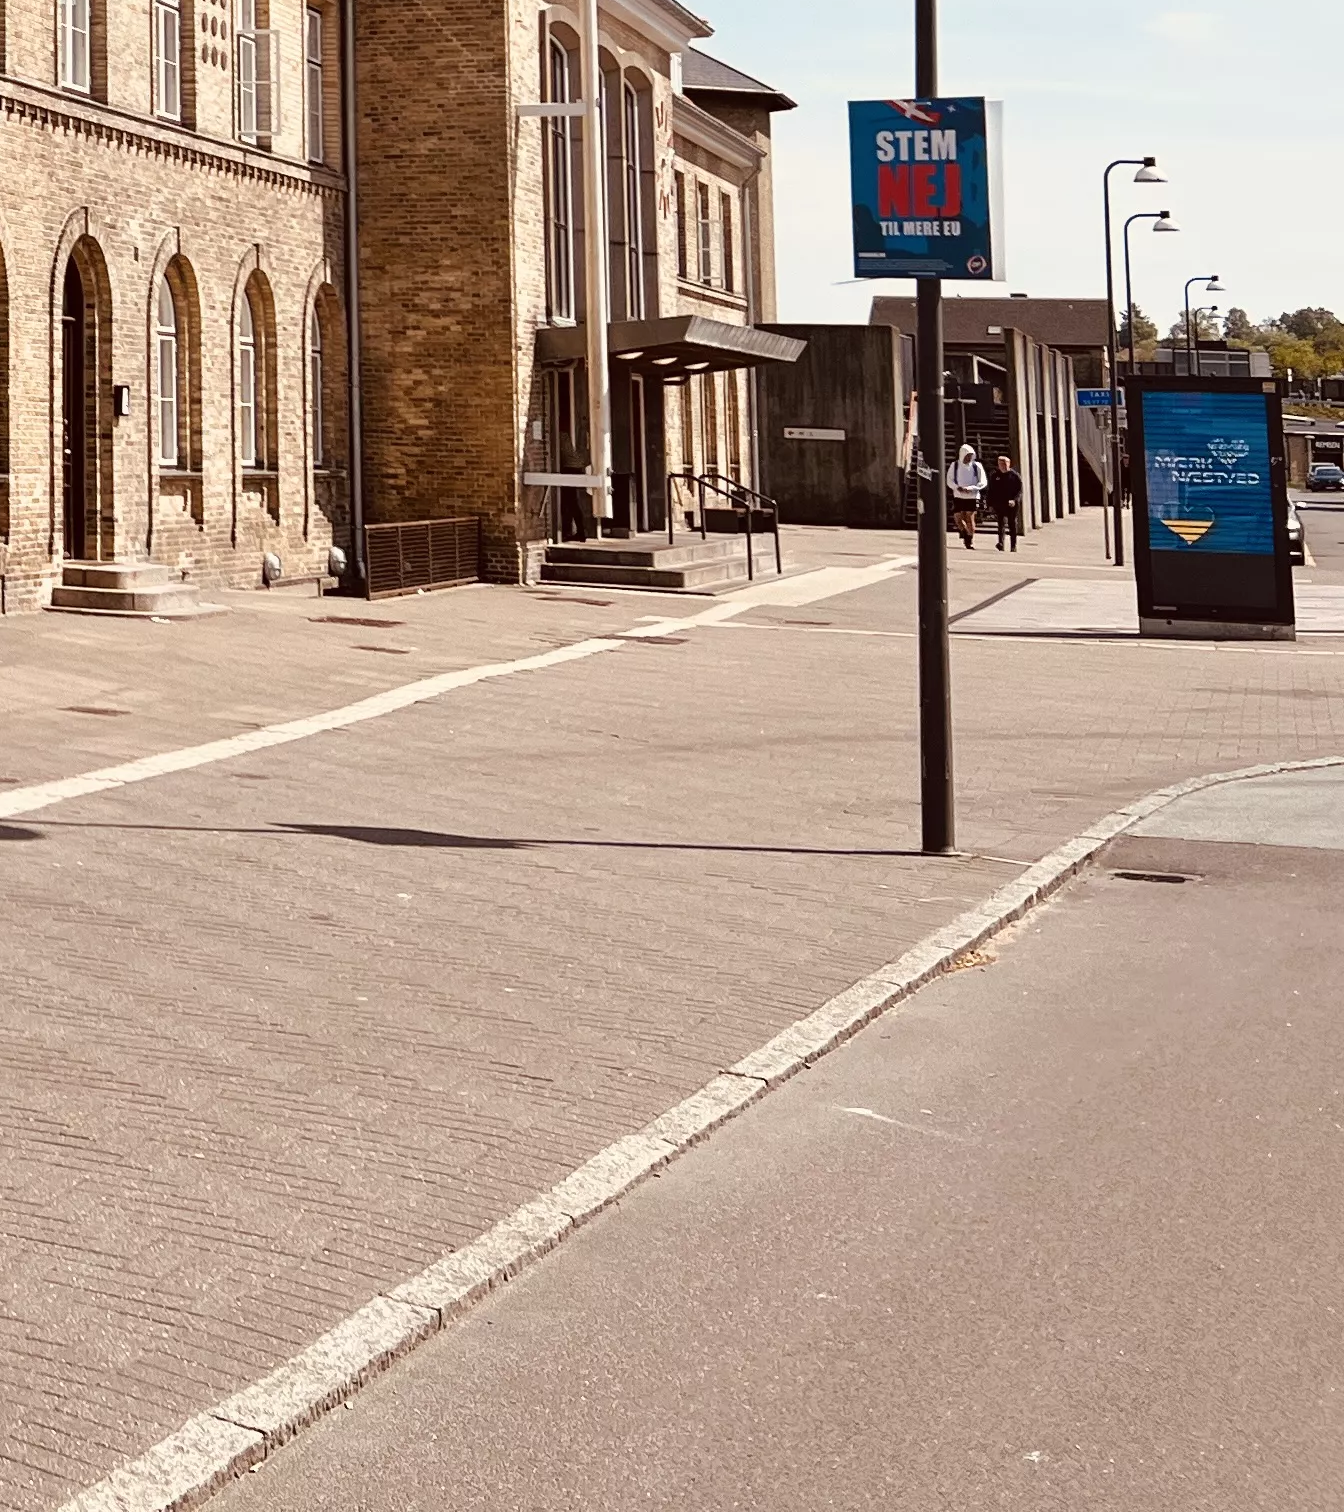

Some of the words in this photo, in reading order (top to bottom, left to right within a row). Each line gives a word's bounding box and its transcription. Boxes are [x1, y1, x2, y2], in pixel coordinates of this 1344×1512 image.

[876, 129, 957, 162] STEM
[878, 163, 961, 218] NEJ
[880, 221, 900, 236] TIL
[903, 220, 941, 236] MERE
[943, 220, 961, 236] EU
